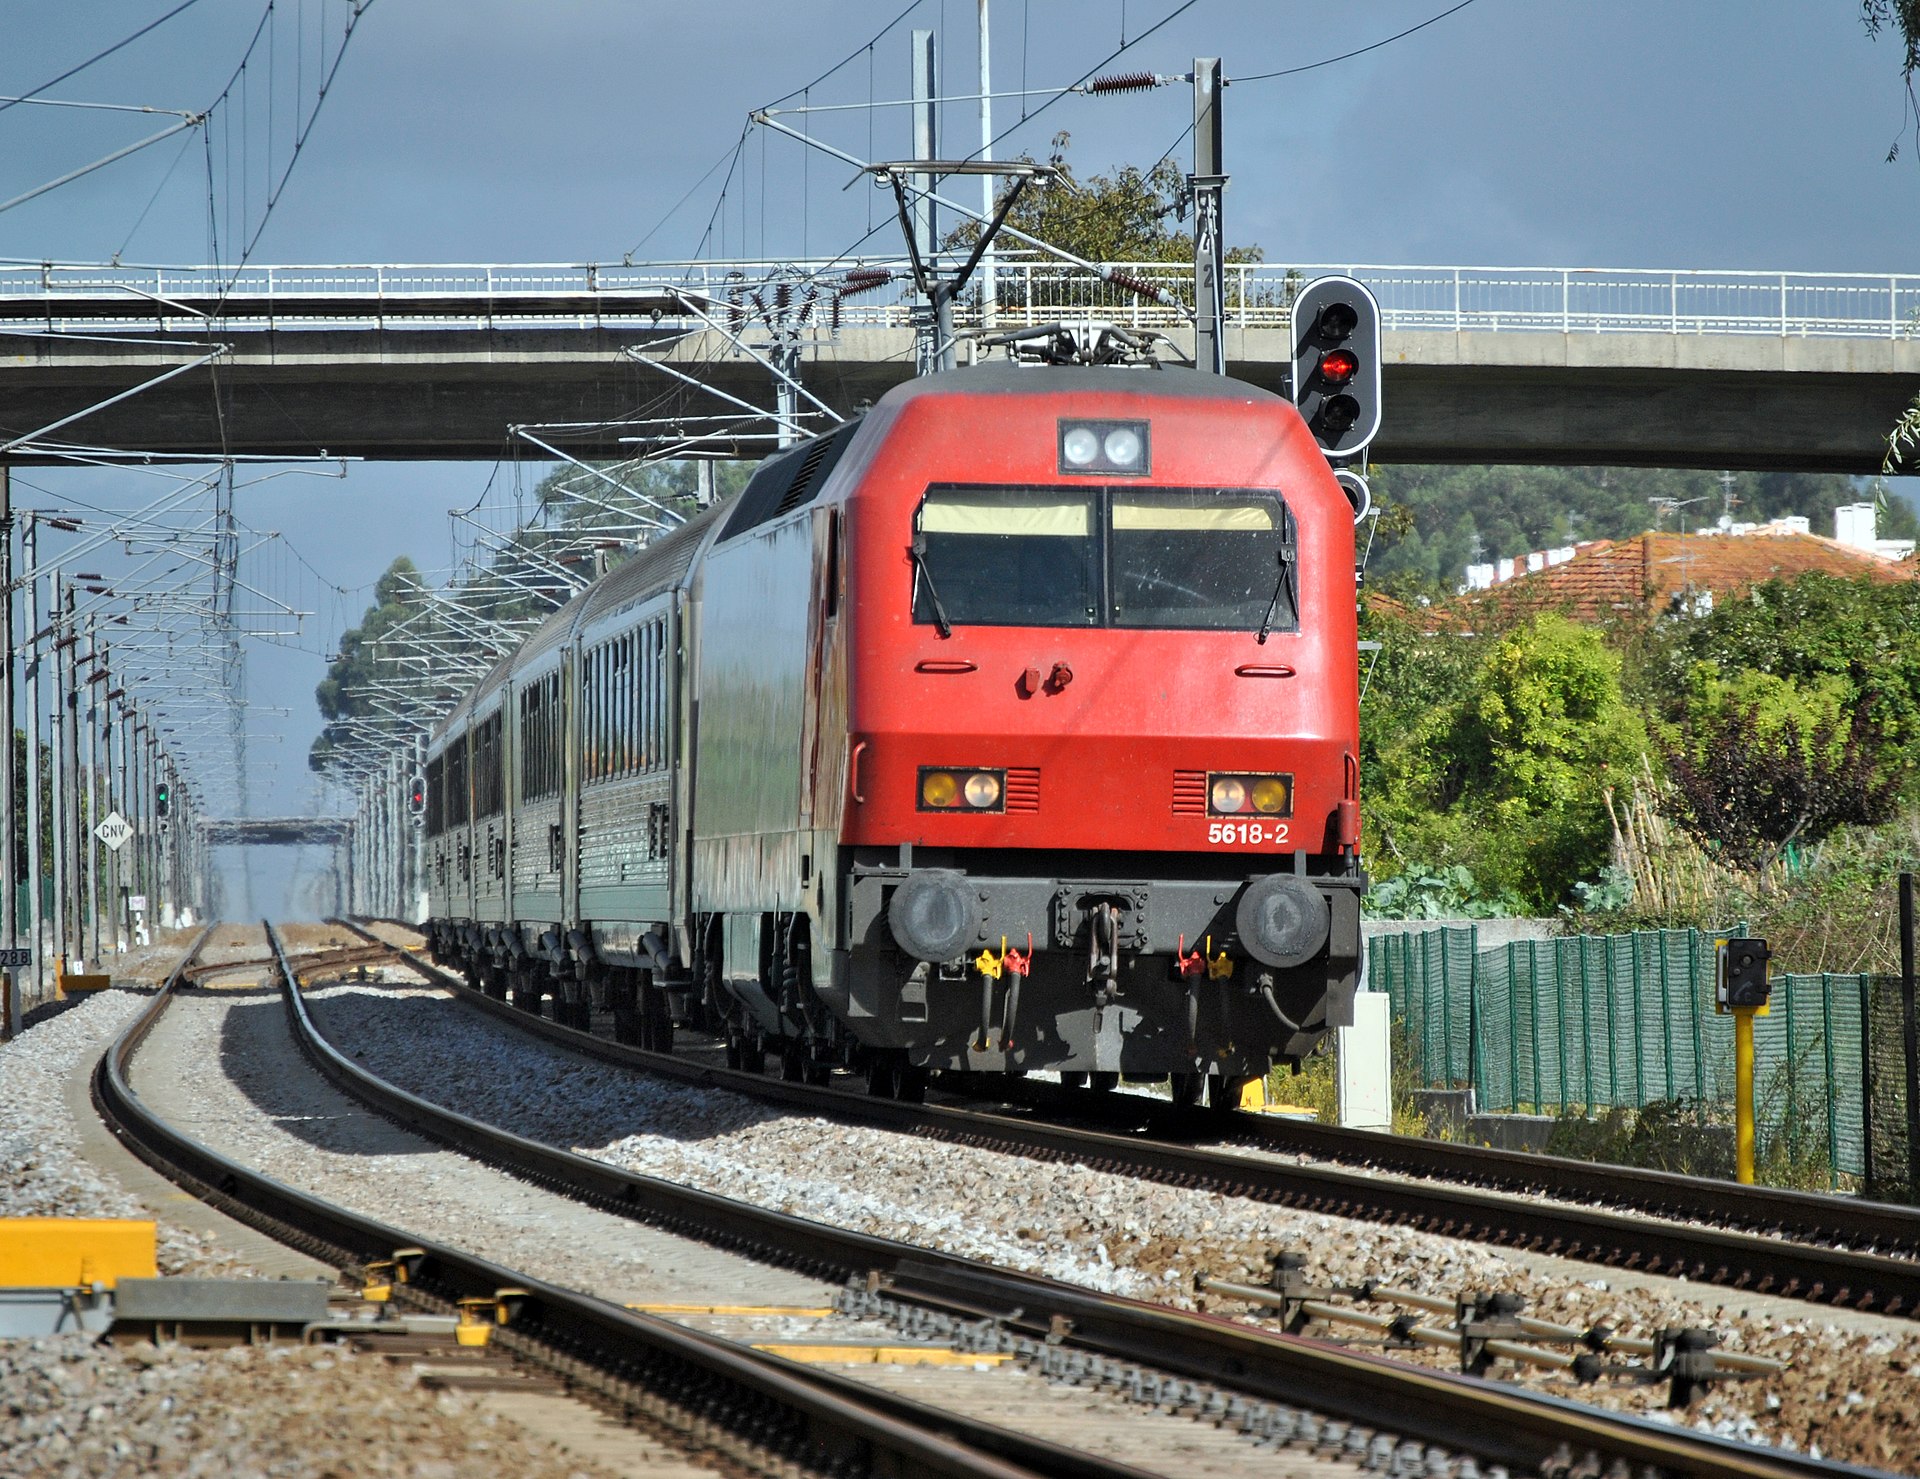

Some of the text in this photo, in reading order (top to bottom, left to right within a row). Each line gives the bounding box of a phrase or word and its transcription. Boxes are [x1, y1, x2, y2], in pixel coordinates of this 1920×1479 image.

[102, 824, 125, 838] CNV
[1208, 823, 1289, 844] 5618-2
[0, 951, 28, 965] 288
